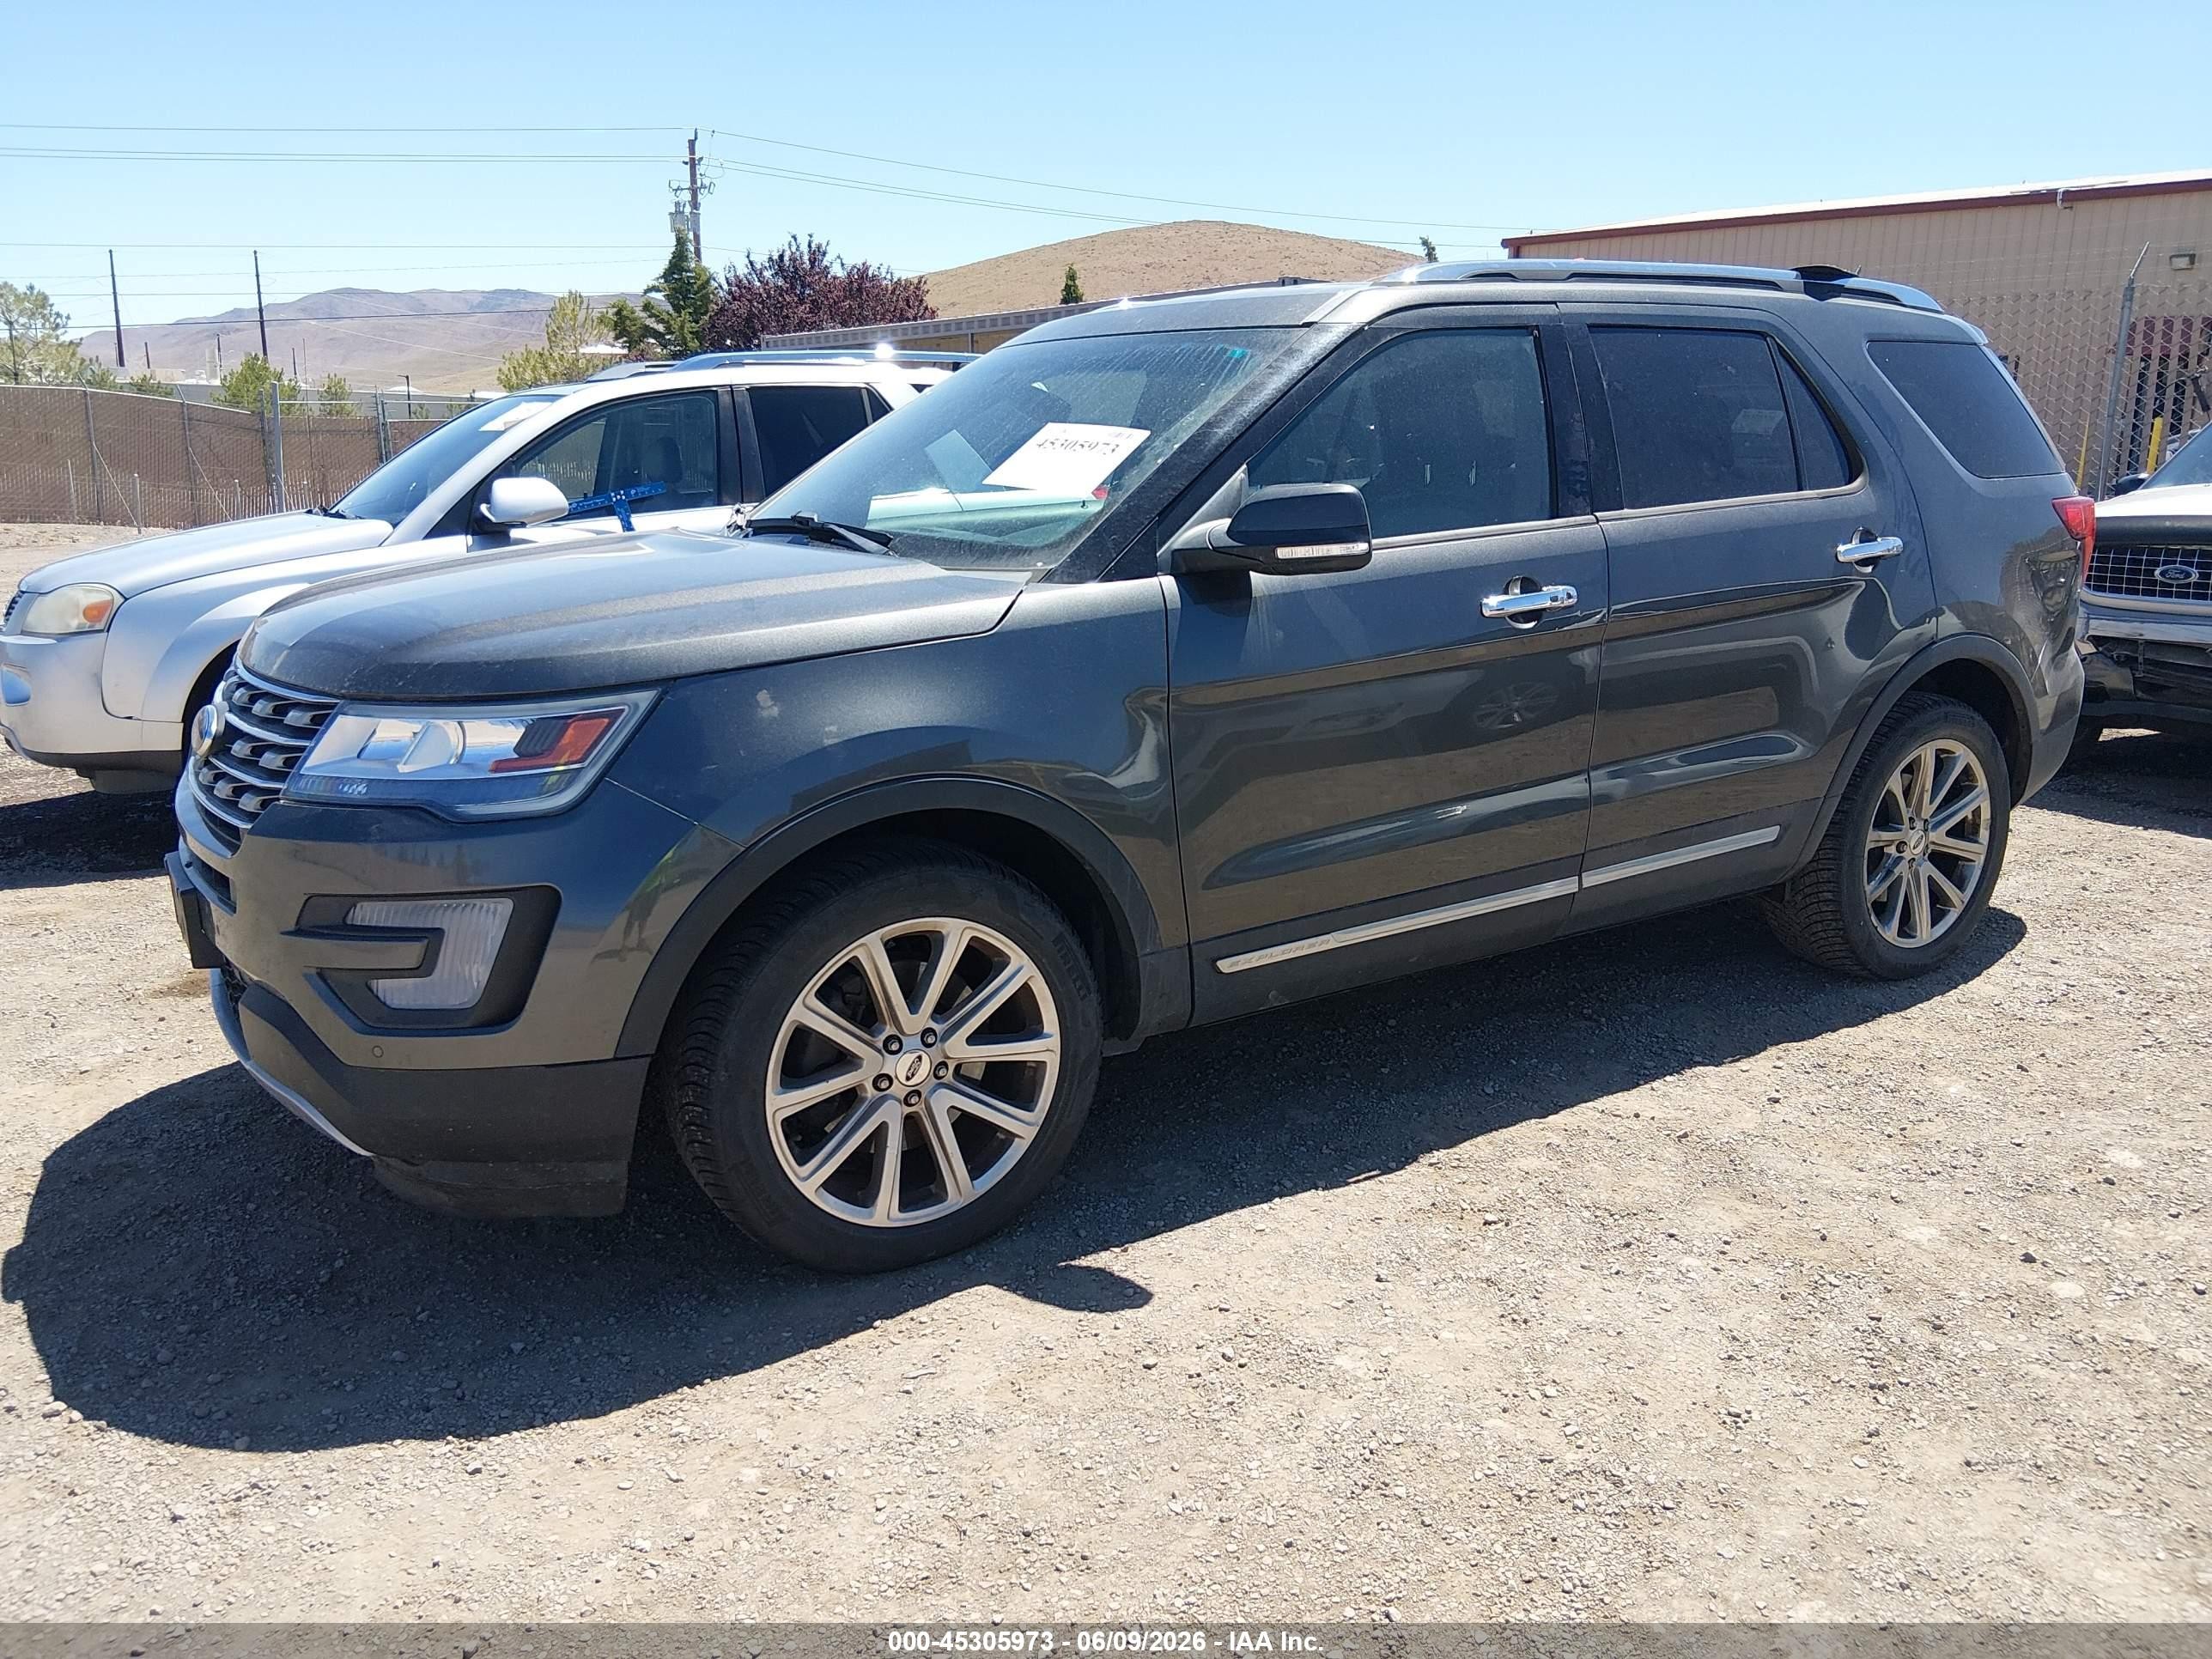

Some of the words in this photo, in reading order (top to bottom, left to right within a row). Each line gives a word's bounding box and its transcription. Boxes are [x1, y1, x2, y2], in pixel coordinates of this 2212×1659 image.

[1036, 438, 1120, 455] 45305973
[1051, 932, 1092, 1002] PIRELLI
[1228, 939, 1331, 969] EXPLORER
